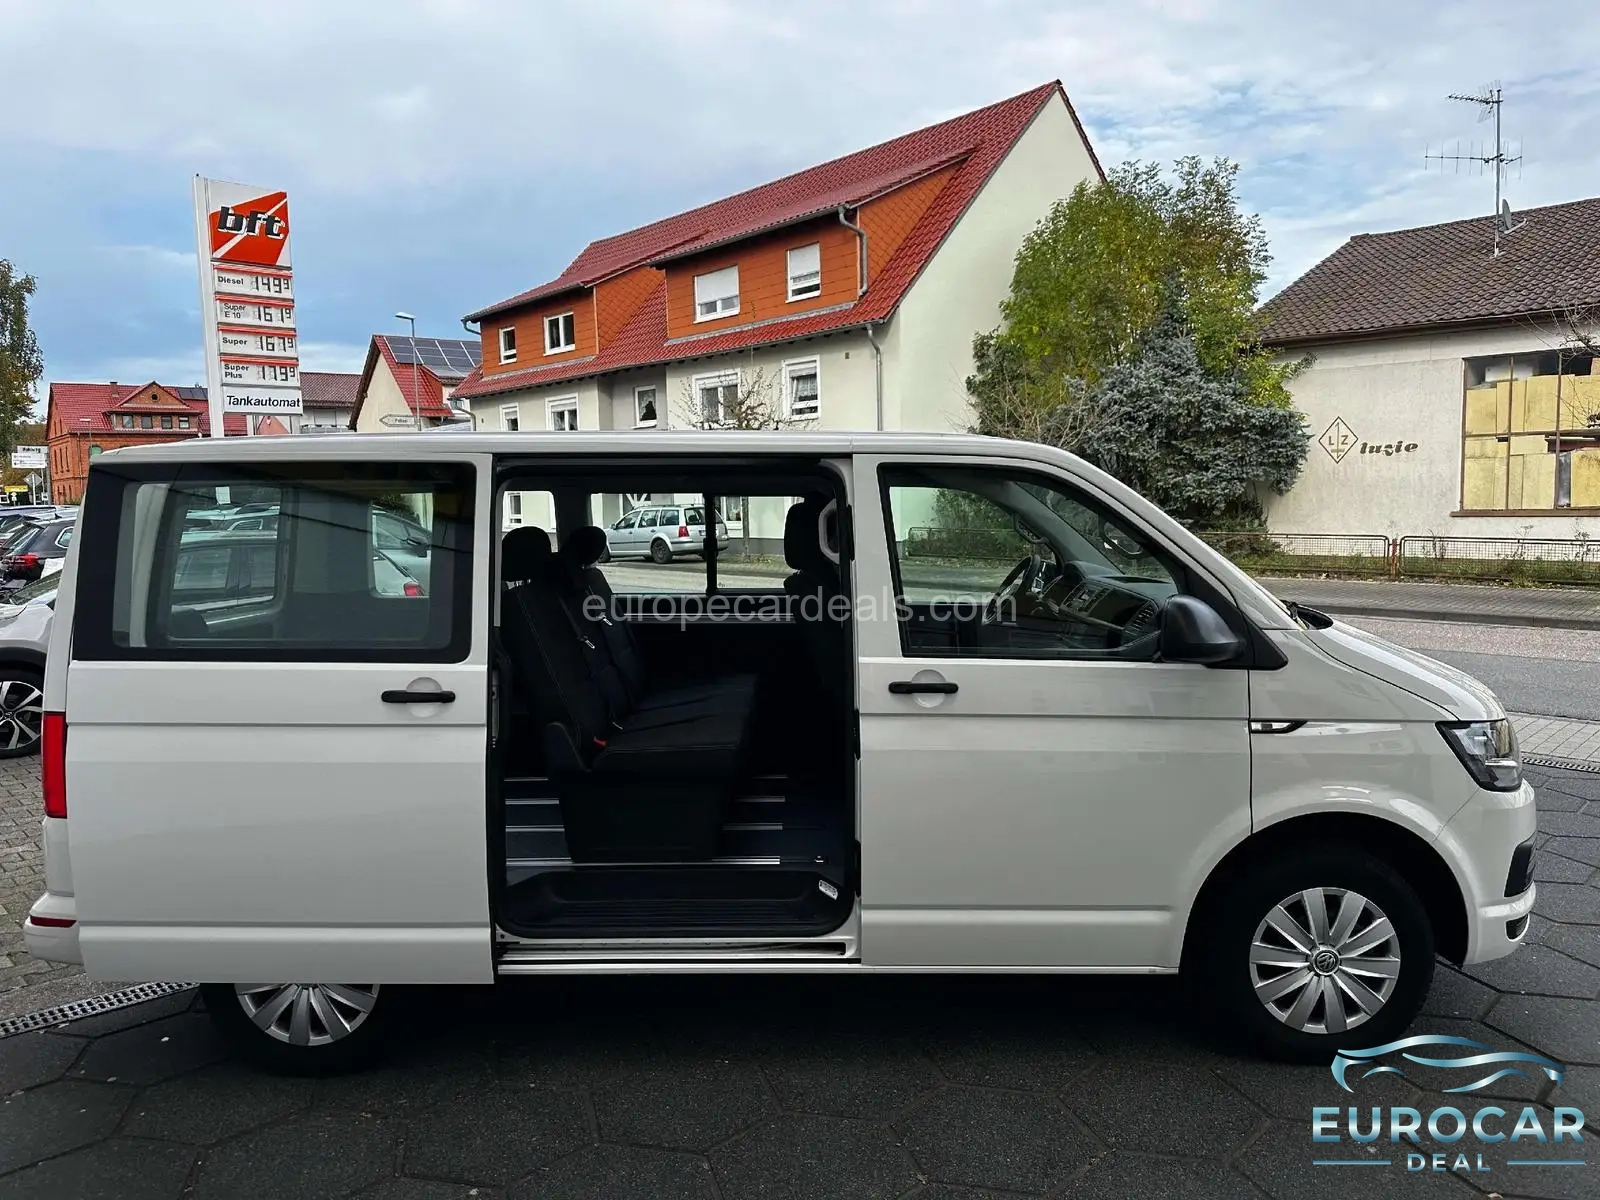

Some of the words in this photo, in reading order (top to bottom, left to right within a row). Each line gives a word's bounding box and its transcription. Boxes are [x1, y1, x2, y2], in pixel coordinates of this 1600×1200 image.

[218, 205, 285, 239] bft
[217, 275, 244, 285] Diesel
[224, 302, 246, 312] Super
[233, 311, 241, 319] 10
[222, 336, 248, 346] Super
[224, 363, 249, 372] Super
[224, 371, 243, 379] Plus
[227, 395, 301, 408] Tankautomat
[1360, 440, 1419, 457] luzie
